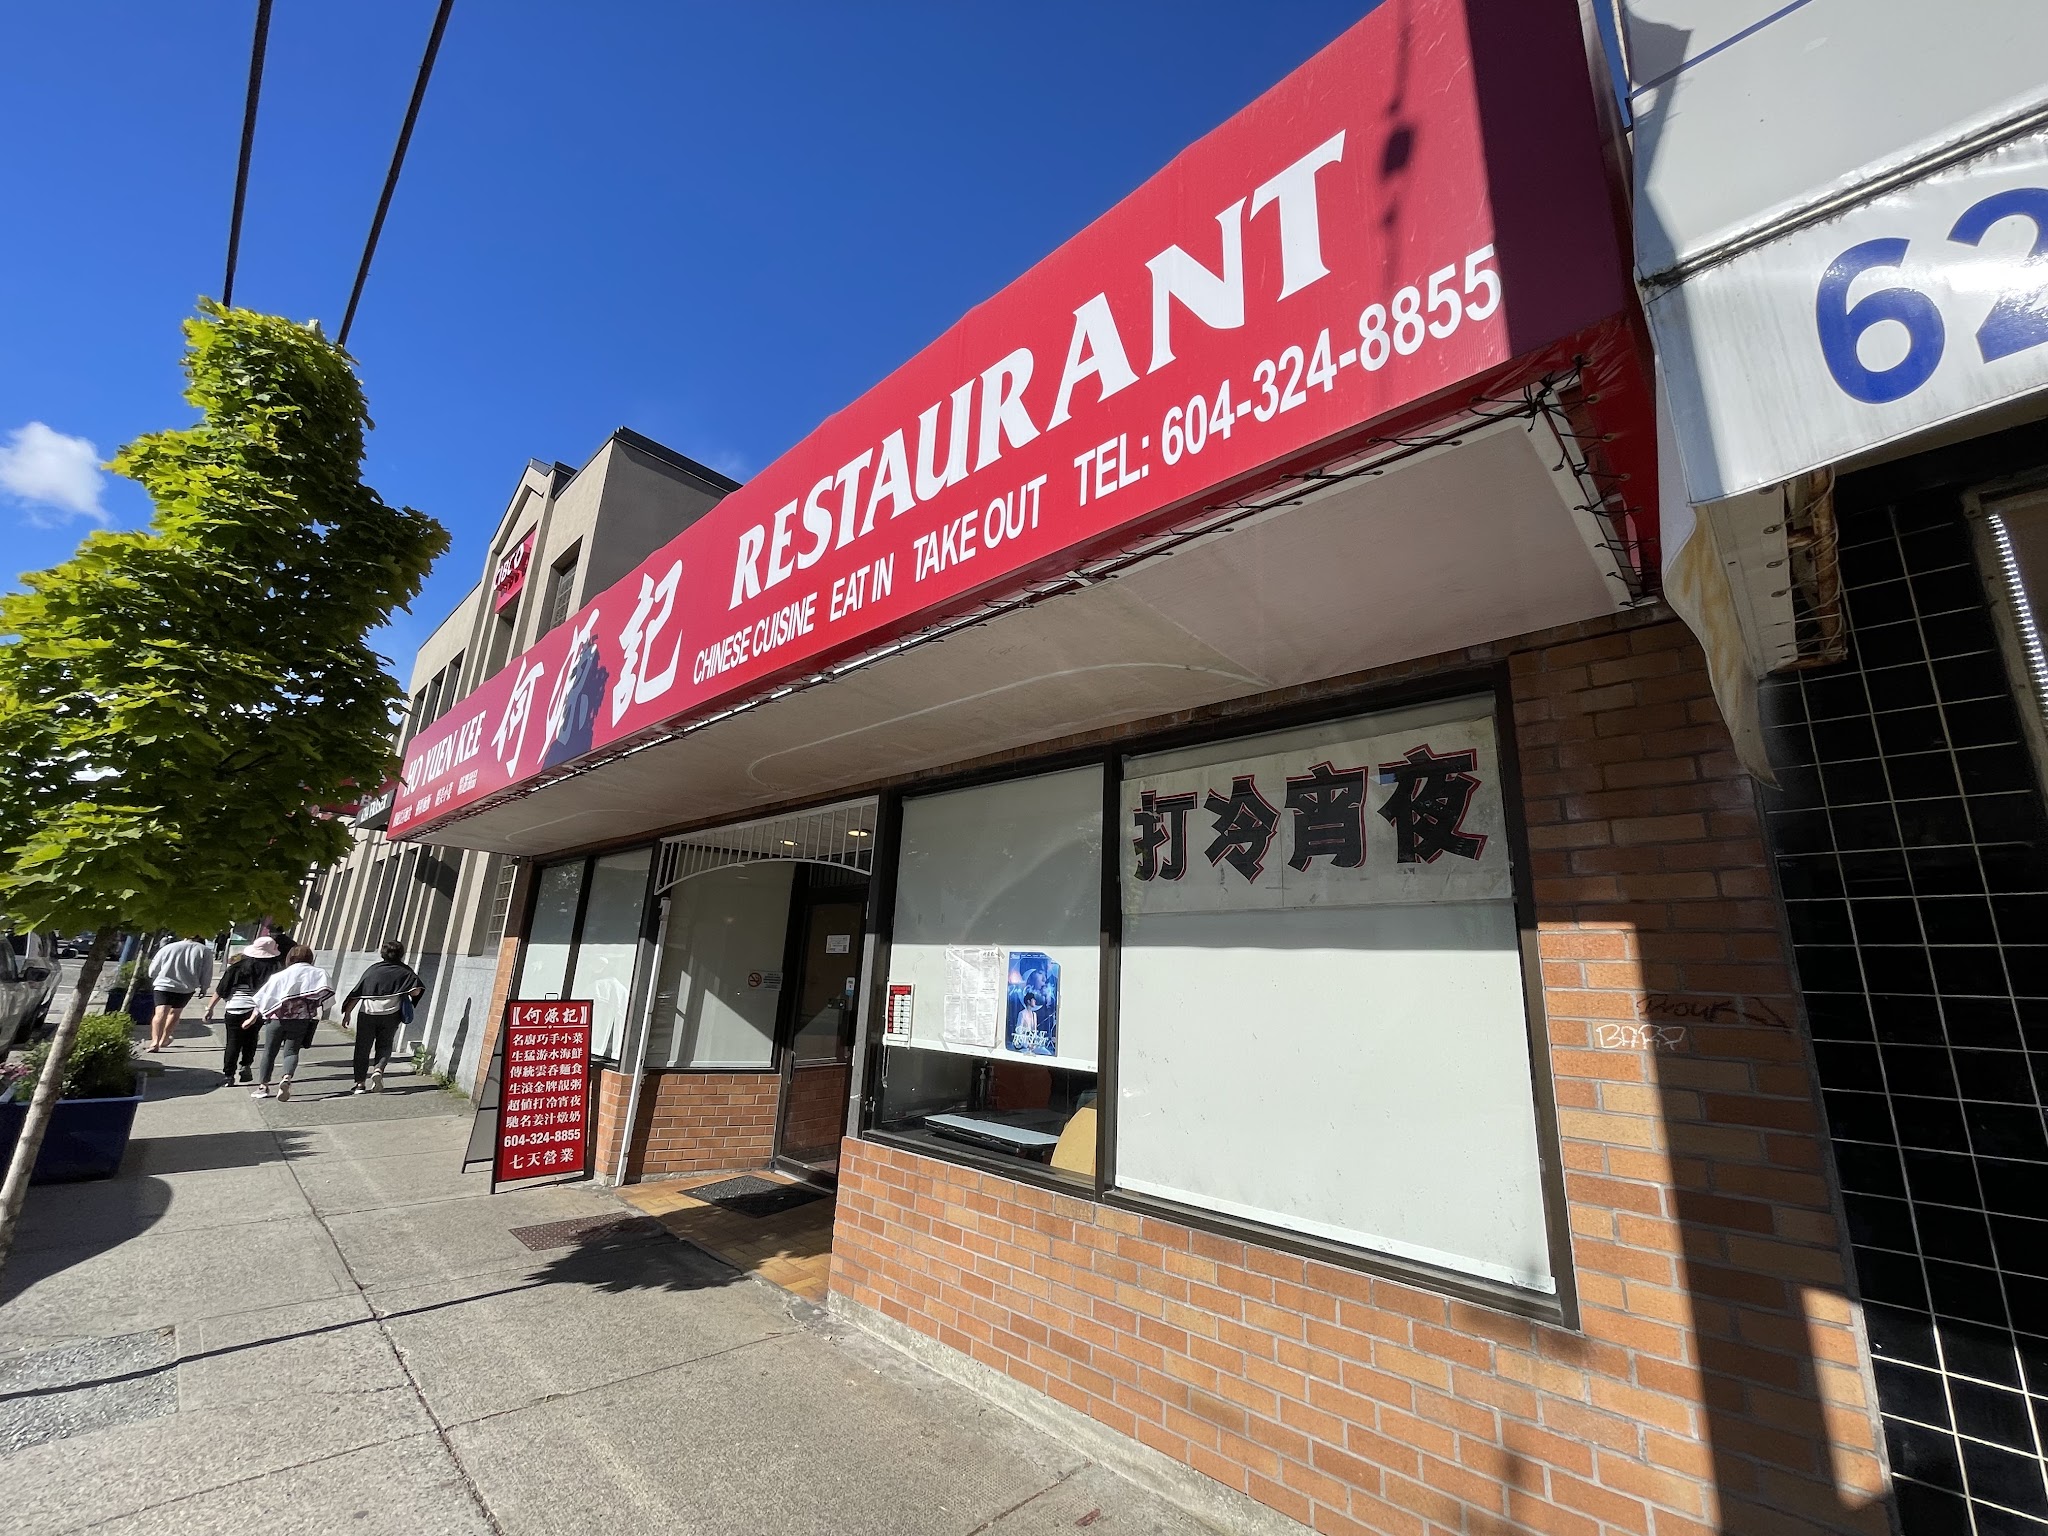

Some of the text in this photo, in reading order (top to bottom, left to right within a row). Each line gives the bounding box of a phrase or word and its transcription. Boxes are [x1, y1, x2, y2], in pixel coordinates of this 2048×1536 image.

[728, 128, 1346, 611] RESTAURANT
[693, 243, 1502, 685] CHINESE CUISINE EAT IN TAKE OUT TEL: 604-324-8855
[402, 754, 424, 798] HO
[421, 729, 459, 787] YUEN
[453, 709, 487, 768] KEE
[1133, 744, 1489, 884] 打冷宵夜
[510, 1047, 583, 1063] 生猛游水海鮮
[504, 1129, 581, 1148] 604-324-8855
[509, 1147, 575, 1170] 七天營業
